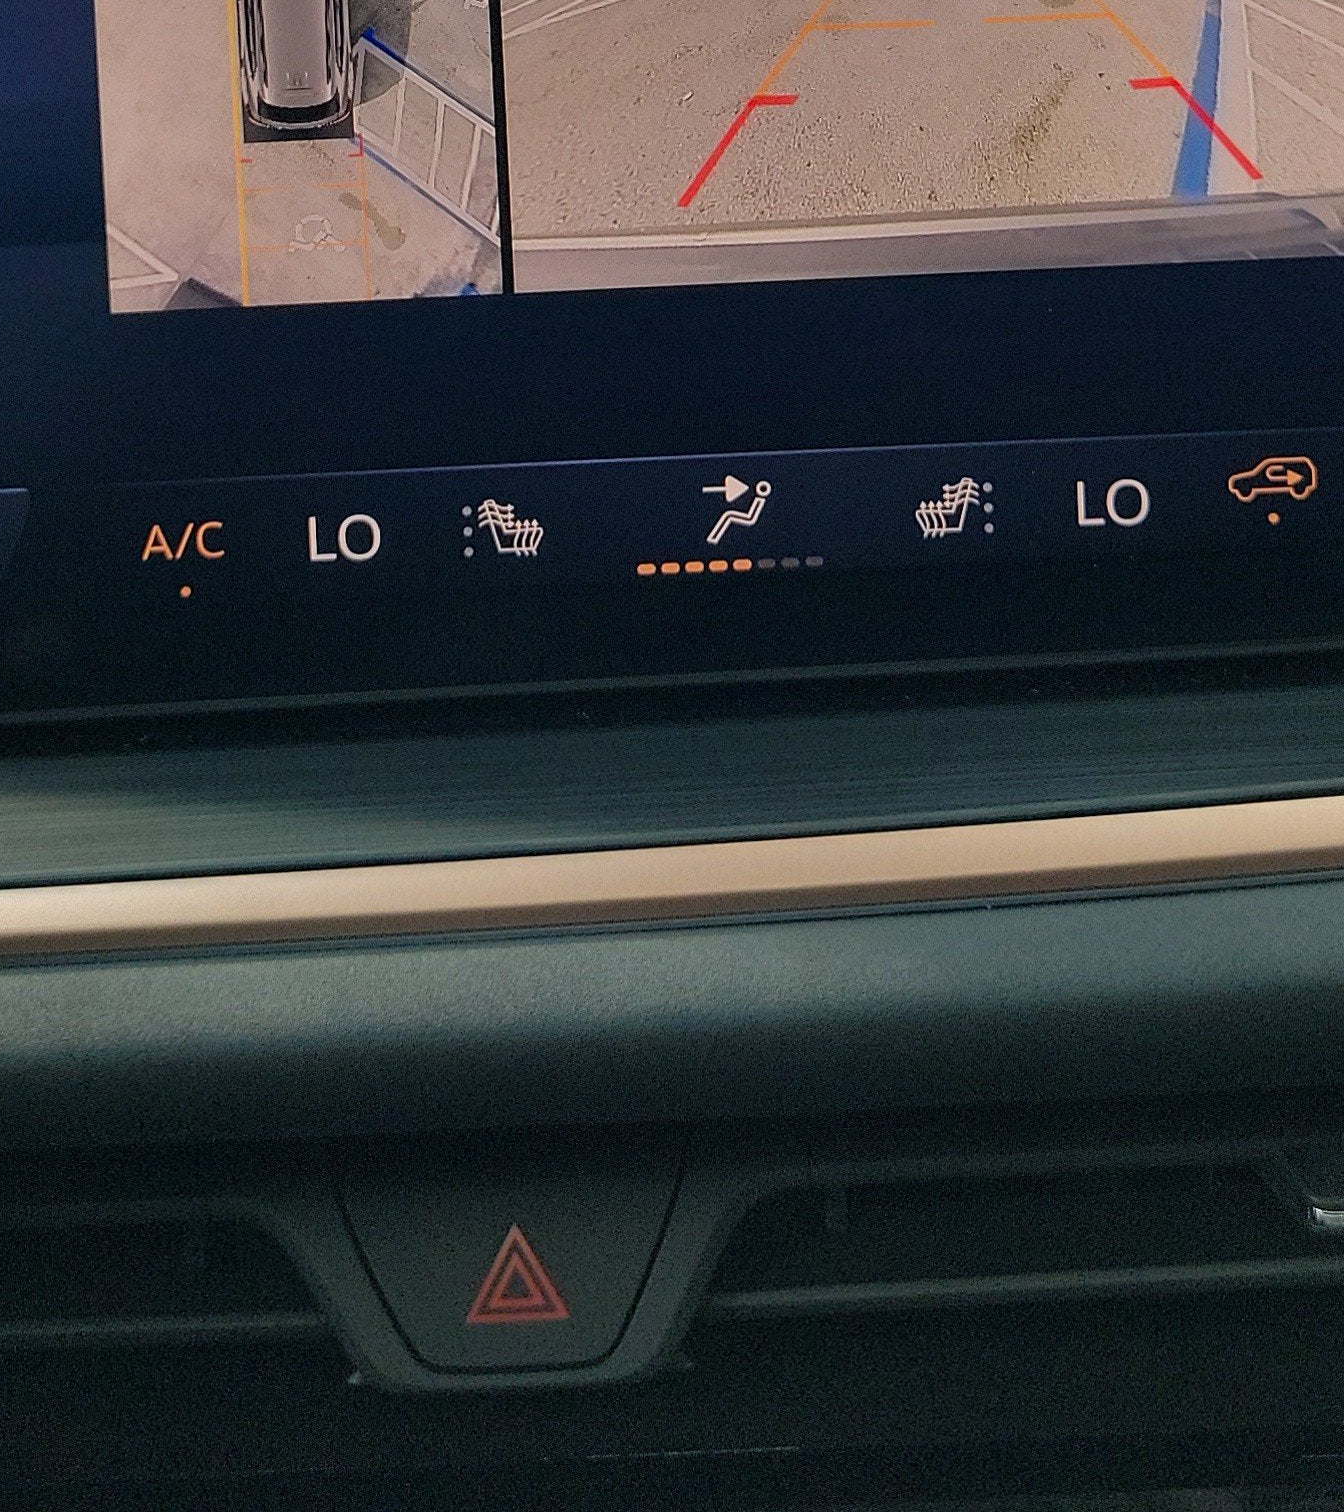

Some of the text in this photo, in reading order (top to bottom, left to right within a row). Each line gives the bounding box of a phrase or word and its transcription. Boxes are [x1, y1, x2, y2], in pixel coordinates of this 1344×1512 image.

[1076, 478, 1151, 527] LO
[141, 519, 226, 561] A/C
[307, 512, 382, 563] LO
